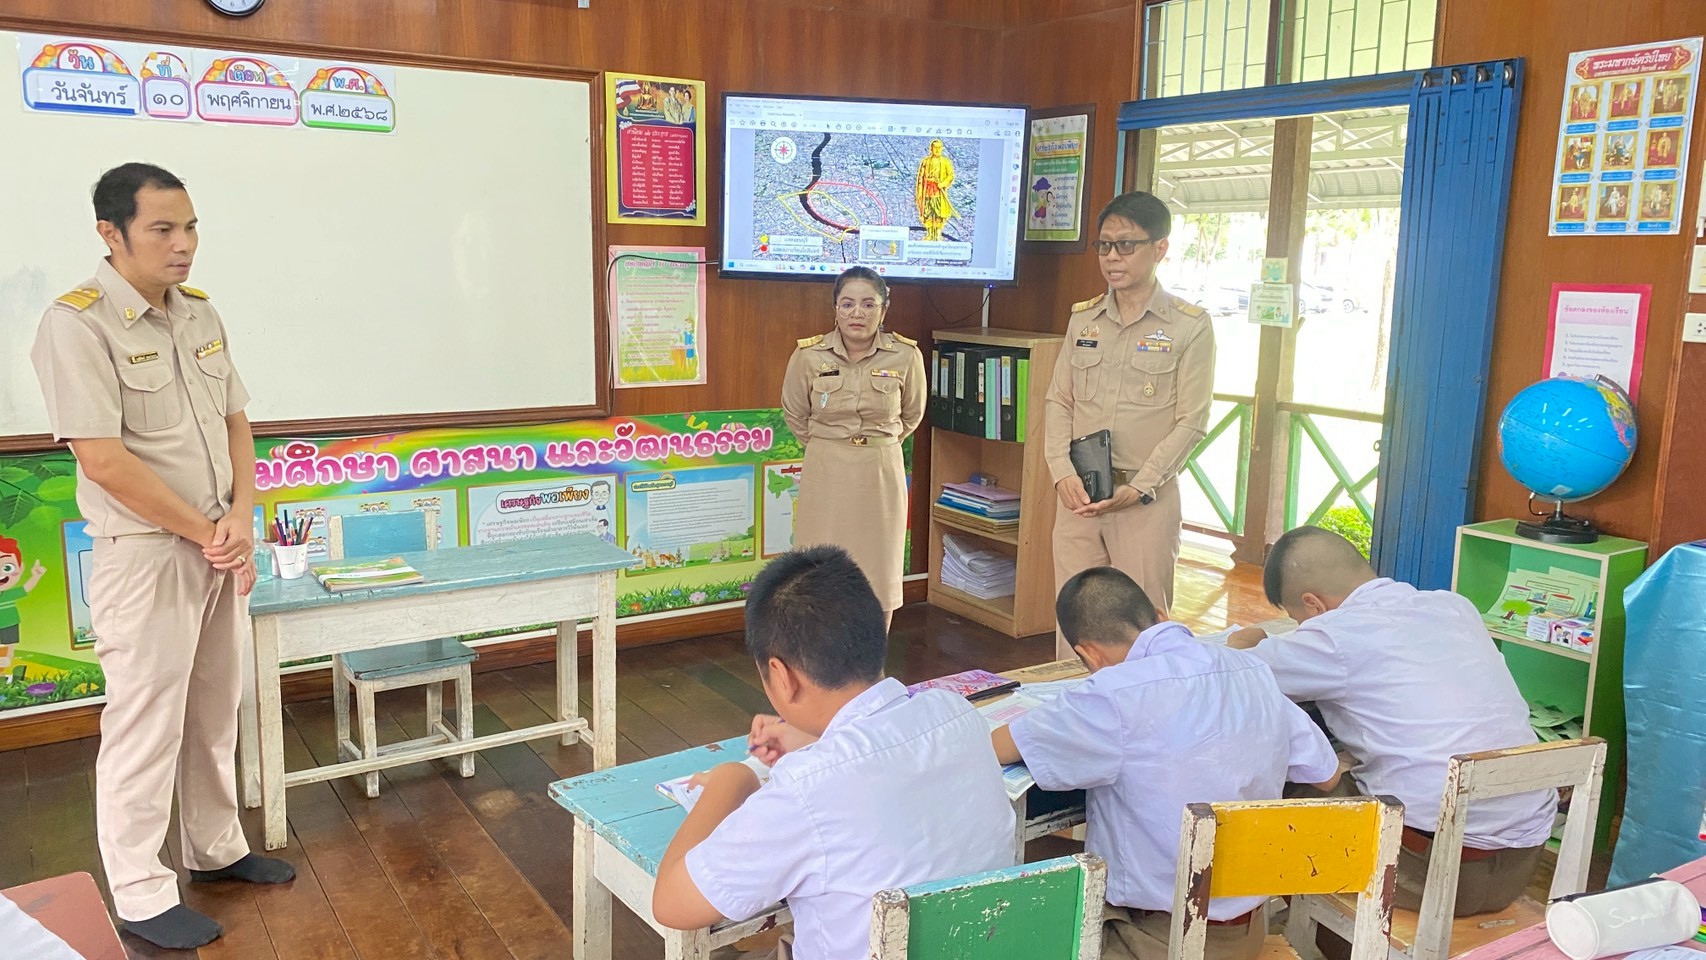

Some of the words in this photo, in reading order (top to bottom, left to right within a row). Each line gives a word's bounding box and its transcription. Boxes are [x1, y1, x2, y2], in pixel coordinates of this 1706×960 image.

[67, 50, 95, 70] วัน
[156, 56, 173, 78] ที่
[1592, 49, 1672, 70] พระมหากษัตริย์ไทย
[228, 61, 264, 84] เดือน
[331, 74, 365, 92] พ.ศ.
[50, 81, 128, 106] วันจันทร์
[152, 93, 184, 107] ๑๐
[207, 90, 292, 112] พฤศจิกายน
[310, 101, 389, 122] พ.ศ.๒๕๖๘
[255, 441, 400, 490] มศึกษา
[411, 444, 537, 479] ศาสนา
[546, 423, 774, 468] และวัฒนธรรม
[500, 486, 590, 509] เศรษฐกิจพอเพียง
